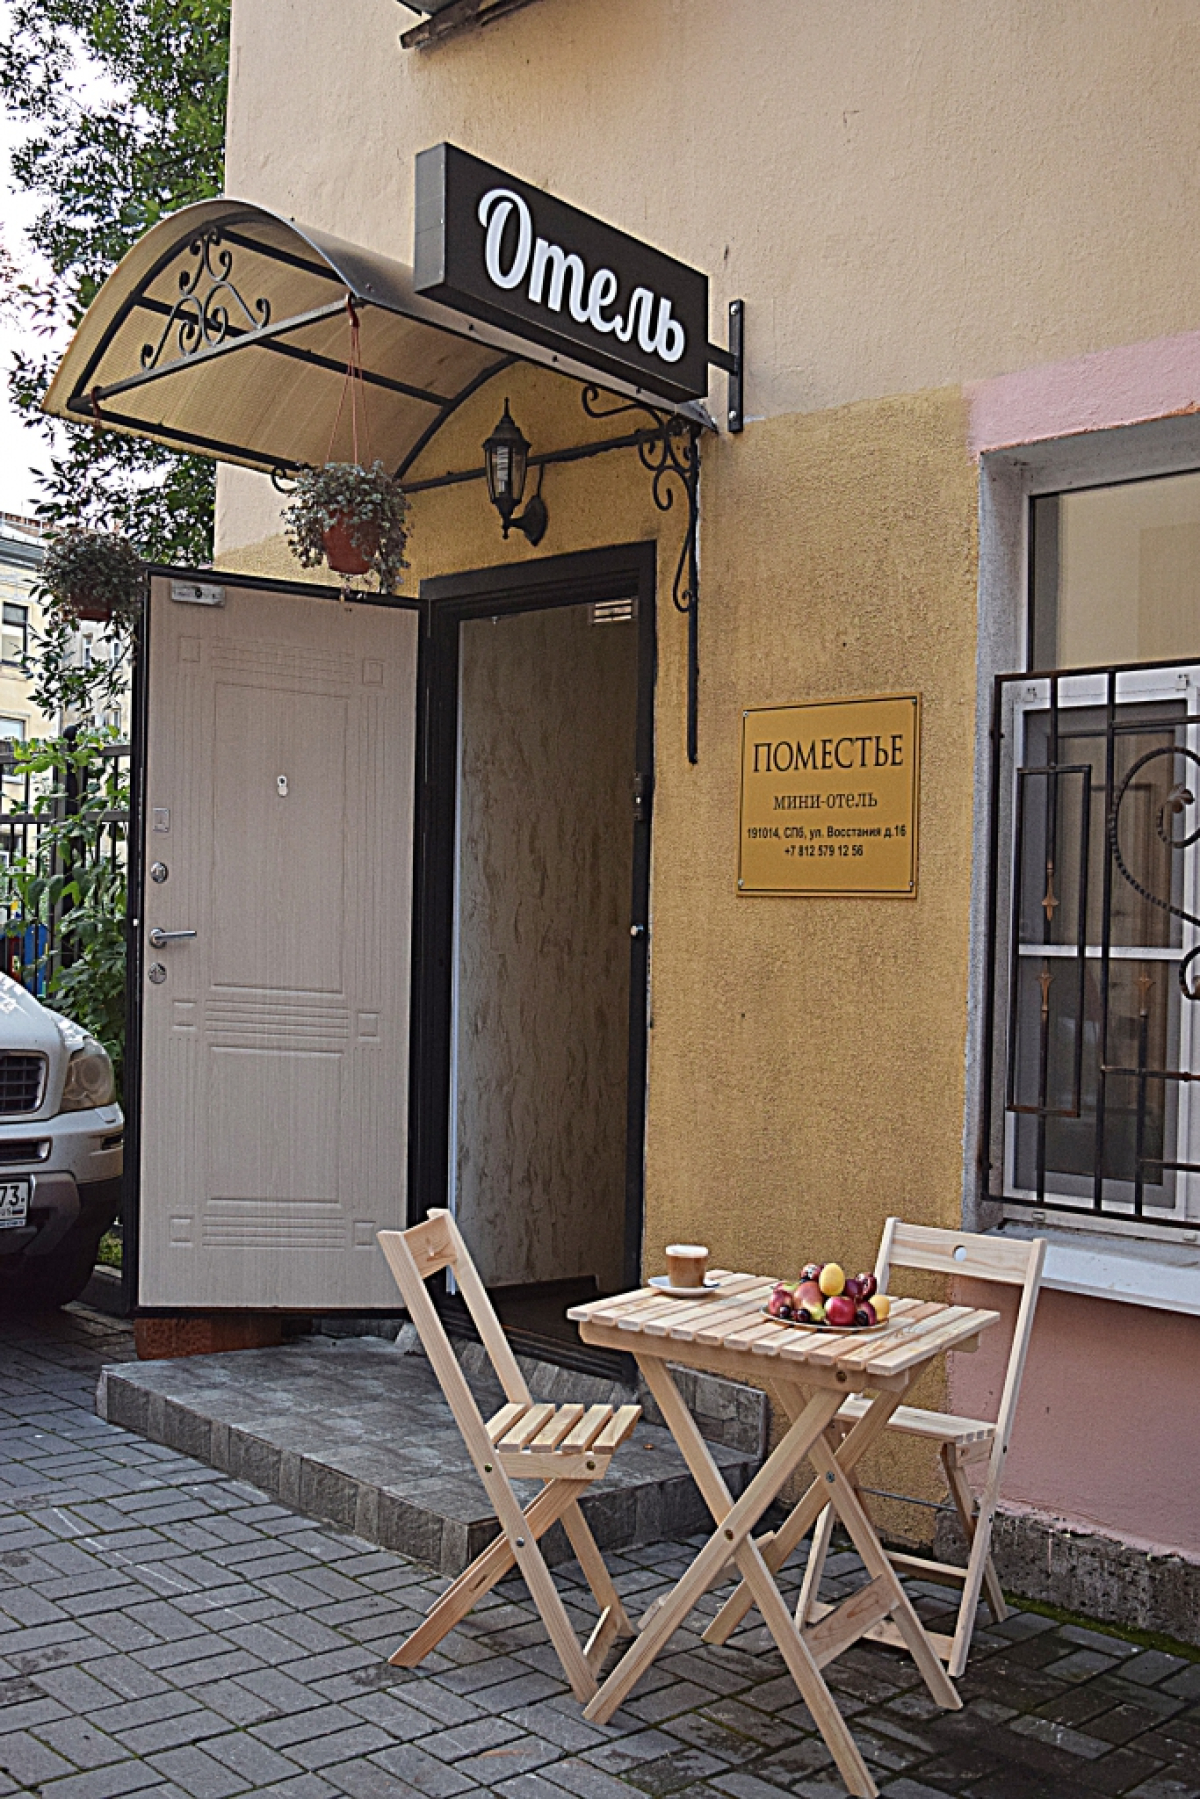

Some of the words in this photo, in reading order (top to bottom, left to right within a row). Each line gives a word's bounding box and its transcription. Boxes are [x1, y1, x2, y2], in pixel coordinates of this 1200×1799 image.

[477, 188, 686, 363] Отель
[753, 734, 904, 774] ПОМЕСТЬЕ
[773, 792, 878, 810] мини-отель
[747, 827, 781, 840] 191014,
[783, 826, 807, 840] СПб,
[809, 828, 825, 841] ул.
[827, 826, 881, 838] Восстания
[784, 845, 796, 857] +7
[798, 845, 815, 856] 812
[817, 845, 835, 856] 579
[837, 845, 849, 856] 12
[851, 845, 864, 856] 56
